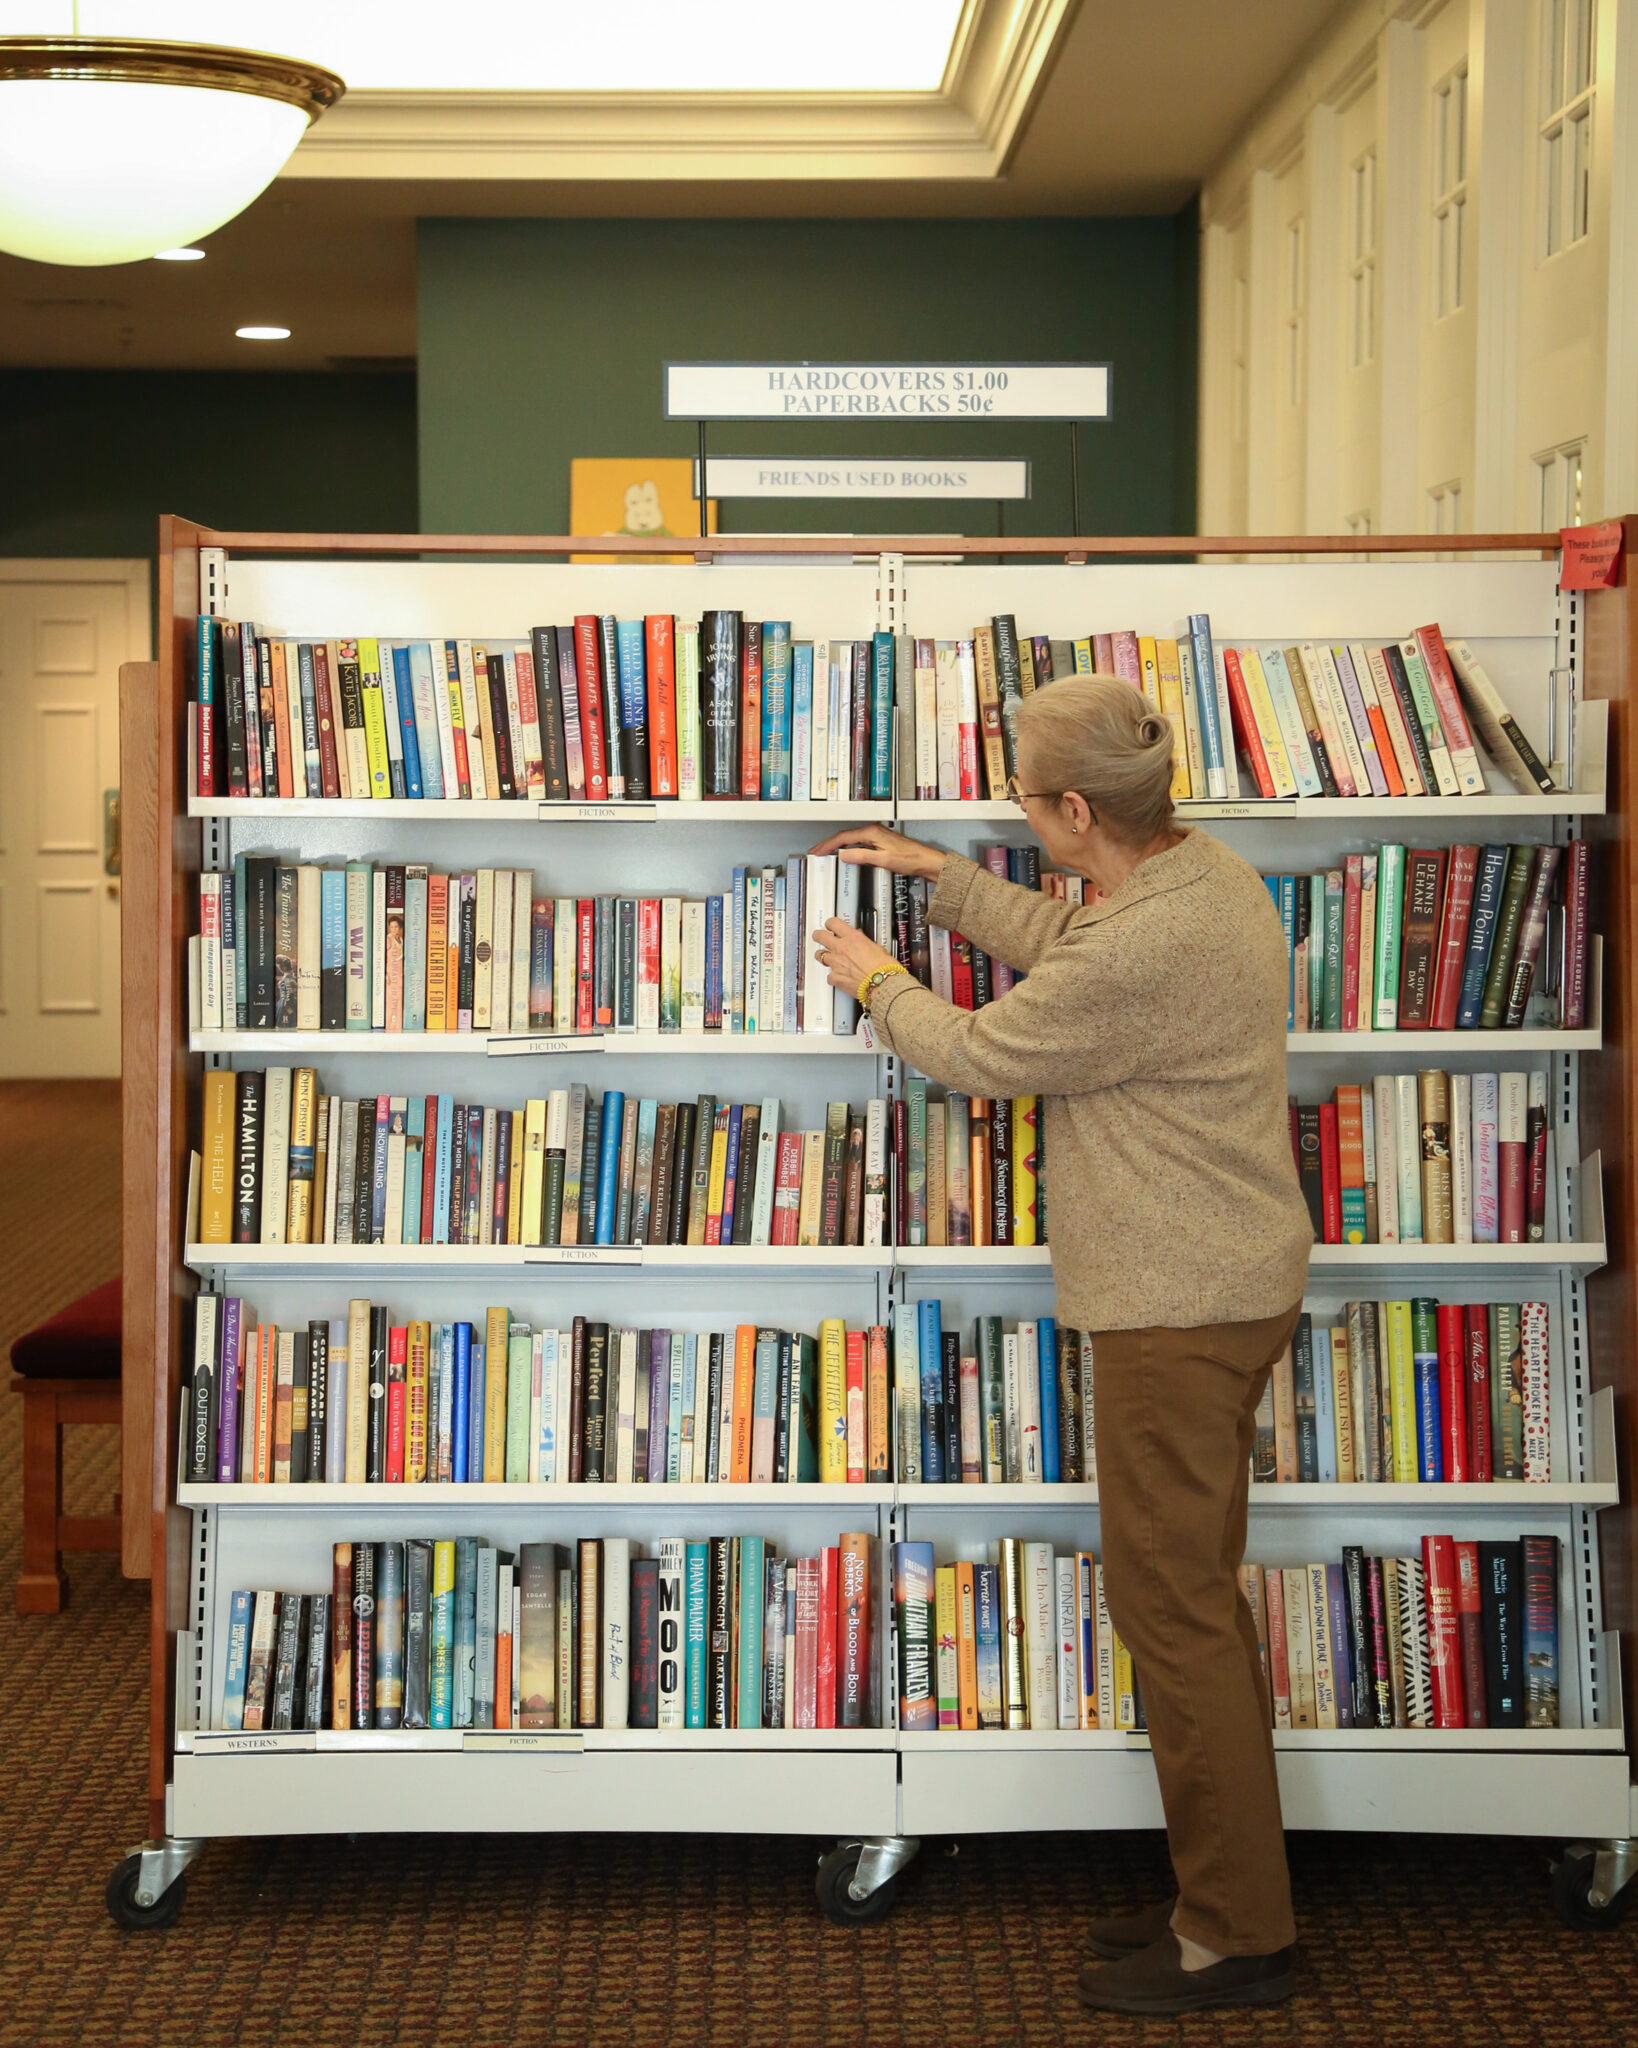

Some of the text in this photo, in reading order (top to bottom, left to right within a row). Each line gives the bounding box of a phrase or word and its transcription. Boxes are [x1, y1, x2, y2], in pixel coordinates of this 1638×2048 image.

[768, 371, 1009, 391] HARDCOVERS $1.00
[783, 393, 994, 415] PAPERBACKS 50¢
[758, 471, 968, 487] FRIENDS USED BOOKS
[302, 656, 311, 687] YOUNG
[540, 634, 550, 689] Elliot Perlman
[622, 633, 632, 724] CHARLES FRAZIER
[707, 654, 736, 663] IRVING
[748, 625, 757, 697] Sue Monk Kidd
[762, 642, 787, 715] NORA ROBERTS
[1370, 656, 1392, 698] Istanbul
[201, 672, 209, 700] Squeeze
[344, 665, 357, 727] KATE JACOBS
[632, 633, 644, 747] COLD MOUNTAIN
[858, 661, 866, 705] RELIABLE
[306, 716, 315, 749] SHACK
[563, 683, 580, 744] VALENTINE
[203, 707, 212, 776] Robert James Waller
[578, 808, 616, 817] FICTION
[224, 879, 232, 942] THE LIGHTNESS
[765, 879, 773, 899] JOEY
[765, 902, 773, 916] DEE
[1413, 864, 1425, 913] LEHANE
[1424, 864, 1436, 914] DENNIS
[1471, 855, 1503, 951] Haven Point
[334, 879, 342, 976] COLD MOUNTAIN
[1577, 932, 1583, 940] IN
[350, 927, 363, 979] WLT
[582, 938, 590, 970] COMPTON
[1408, 970, 1416, 988] DAY
[1416, 956, 1426, 1004] THE GIVEN
[529, 1041, 568, 1051] FICTION
[298, 1069, 310, 1141] JOHN GRISHAM
[1486, 1080, 1494, 1111] SUNNY
[872, 1104, 880, 1144] JEANNE
[212, 1133, 224, 1194] THE HELP
[240, 1099, 257, 1203] HAMILTON
[376, 1128, 385, 1188] SNOW FALLING
[781, 1139, 790, 1184] MACOMBER
[241, 1206, 249, 1226] Affair
[289, 1185, 299, 1227] MOUNTAIN
[300, 1195, 308, 1217] GRAY
[655, 1187, 664, 1237] KELLERMAN
[1441, 1172, 1450, 1219] RISE TO
[561, 1250, 599, 1259] FICTION
[354, 1317, 363, 1389] River of Heaven
[588, 1336, 604, 1401] Perfect
[826, 1328, 840, 1413] THE JETSETTERS
[1530, 1316, 1541, 1422] THE HEART BROKE IN
[672, 1382, 681, 1402] MILK
[760, 1348, 771, 1413] JODI PICOULT
[792, 1359, 800, 1404] ANT FARM
[196, 1388, 208, 1462] OUTFOXED
[1337, 1370, 1350, 1462] SMALL ISLAND
[737, 1417, 745, 1465] PHILOMENA
[717, 1542, 726, 1580] MAEVE
[843, 1552, 856, 1597] ROBERTS
[855, 1560, 864, 1592] NORA
[437, 1591, 446, 1631] KRAUSS
[690, 1558, 704, 1642] DIANA PALMER
[1060, 1573, 1074, 1637] CONRAD
[1351, 1552, 1364, 1650] MARY HIGGINS CLARK
[1527, 1541, 1553, 1633] PAT CONROY
[850, 1608, 856, 1616] OF
[1312, 1570, 1326, 1664] BRINGING DOWN THE DUKE
[848, 1619, 859, 1656] BLOOD
[906, 1572, 928, 1704] JONATHAN FRANZEN
[435, 1635, 445, 1707] FOREST DARK
[849, 1674, 859, 1703] BONE
[1100, 1649, 1110, 1716] BRET LOTT
[227, 1738, 278, 1749] WESTERNS
[509, 1737, 539, 1745] FICTION
